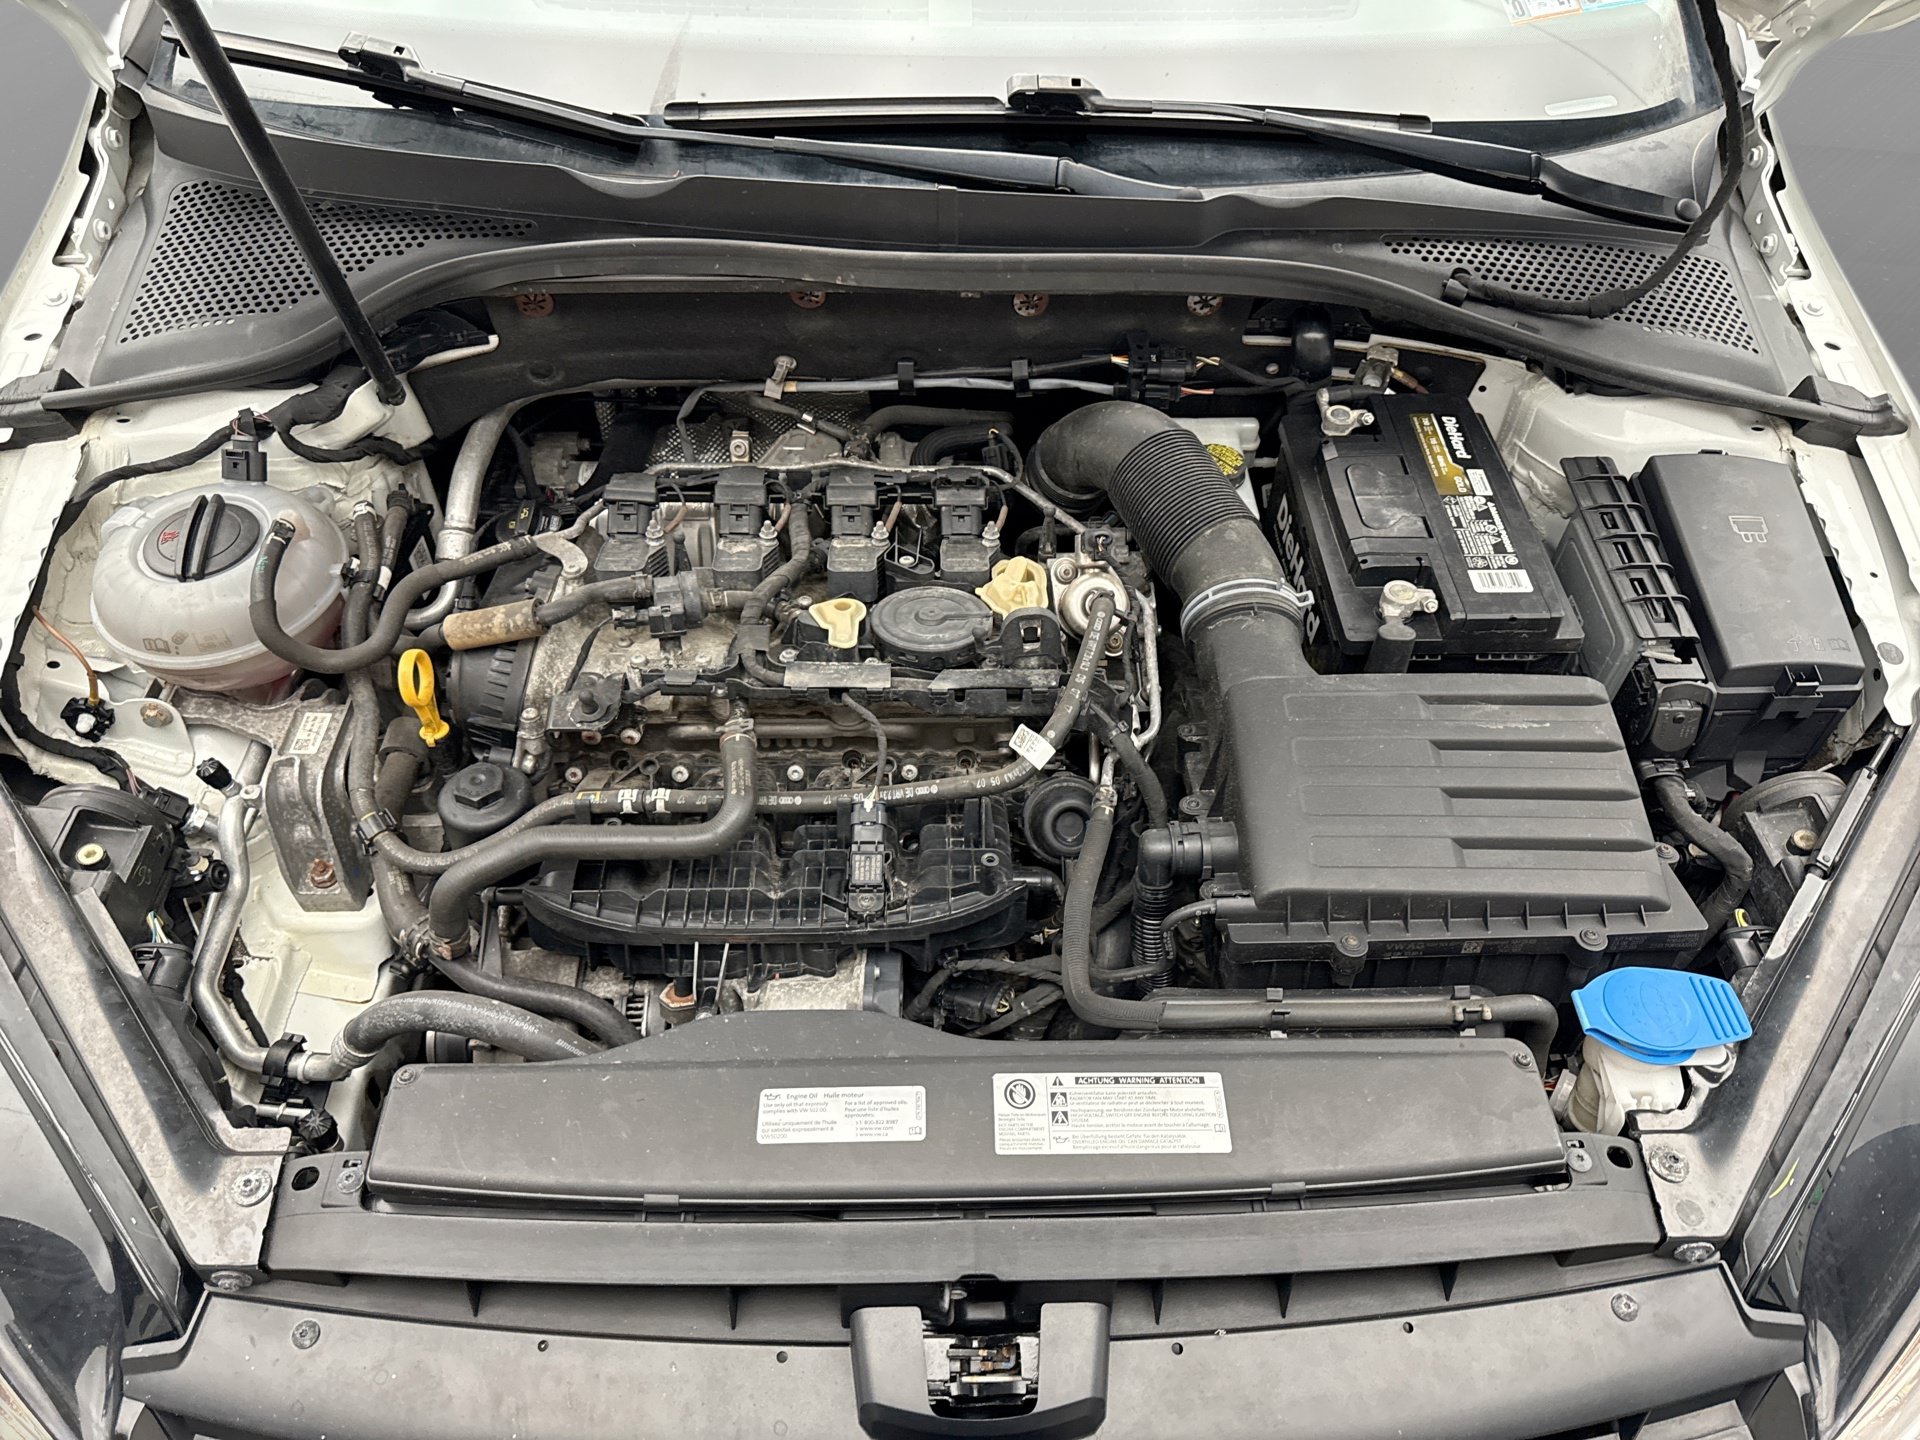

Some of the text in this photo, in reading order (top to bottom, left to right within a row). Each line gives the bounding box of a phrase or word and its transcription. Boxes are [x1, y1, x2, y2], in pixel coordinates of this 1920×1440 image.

[1441, 416, 1472, 458] DieHard
[1454, 476, 1468, 492] GOLD
[976, 778, 986, 789] 07
[990, 776, 1000, 786] 05
[905, 787, 914, 798] DE
